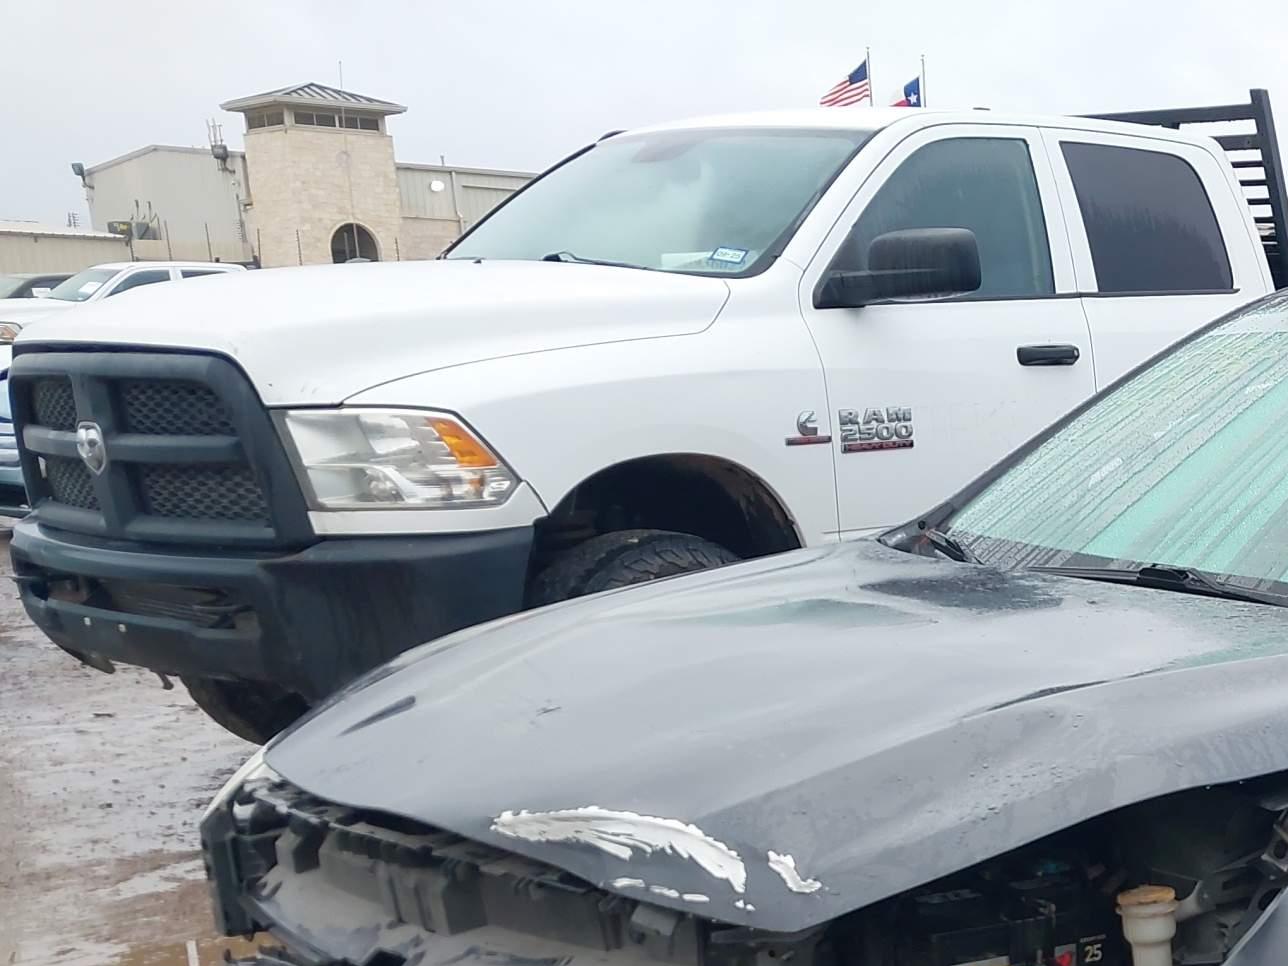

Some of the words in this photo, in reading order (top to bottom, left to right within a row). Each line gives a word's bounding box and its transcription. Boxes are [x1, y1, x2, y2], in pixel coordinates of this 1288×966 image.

[838, 407, 912, 425] RAM
[840, 423, 913, 442] 2500
[1084, 943, 1103, 963] 25
